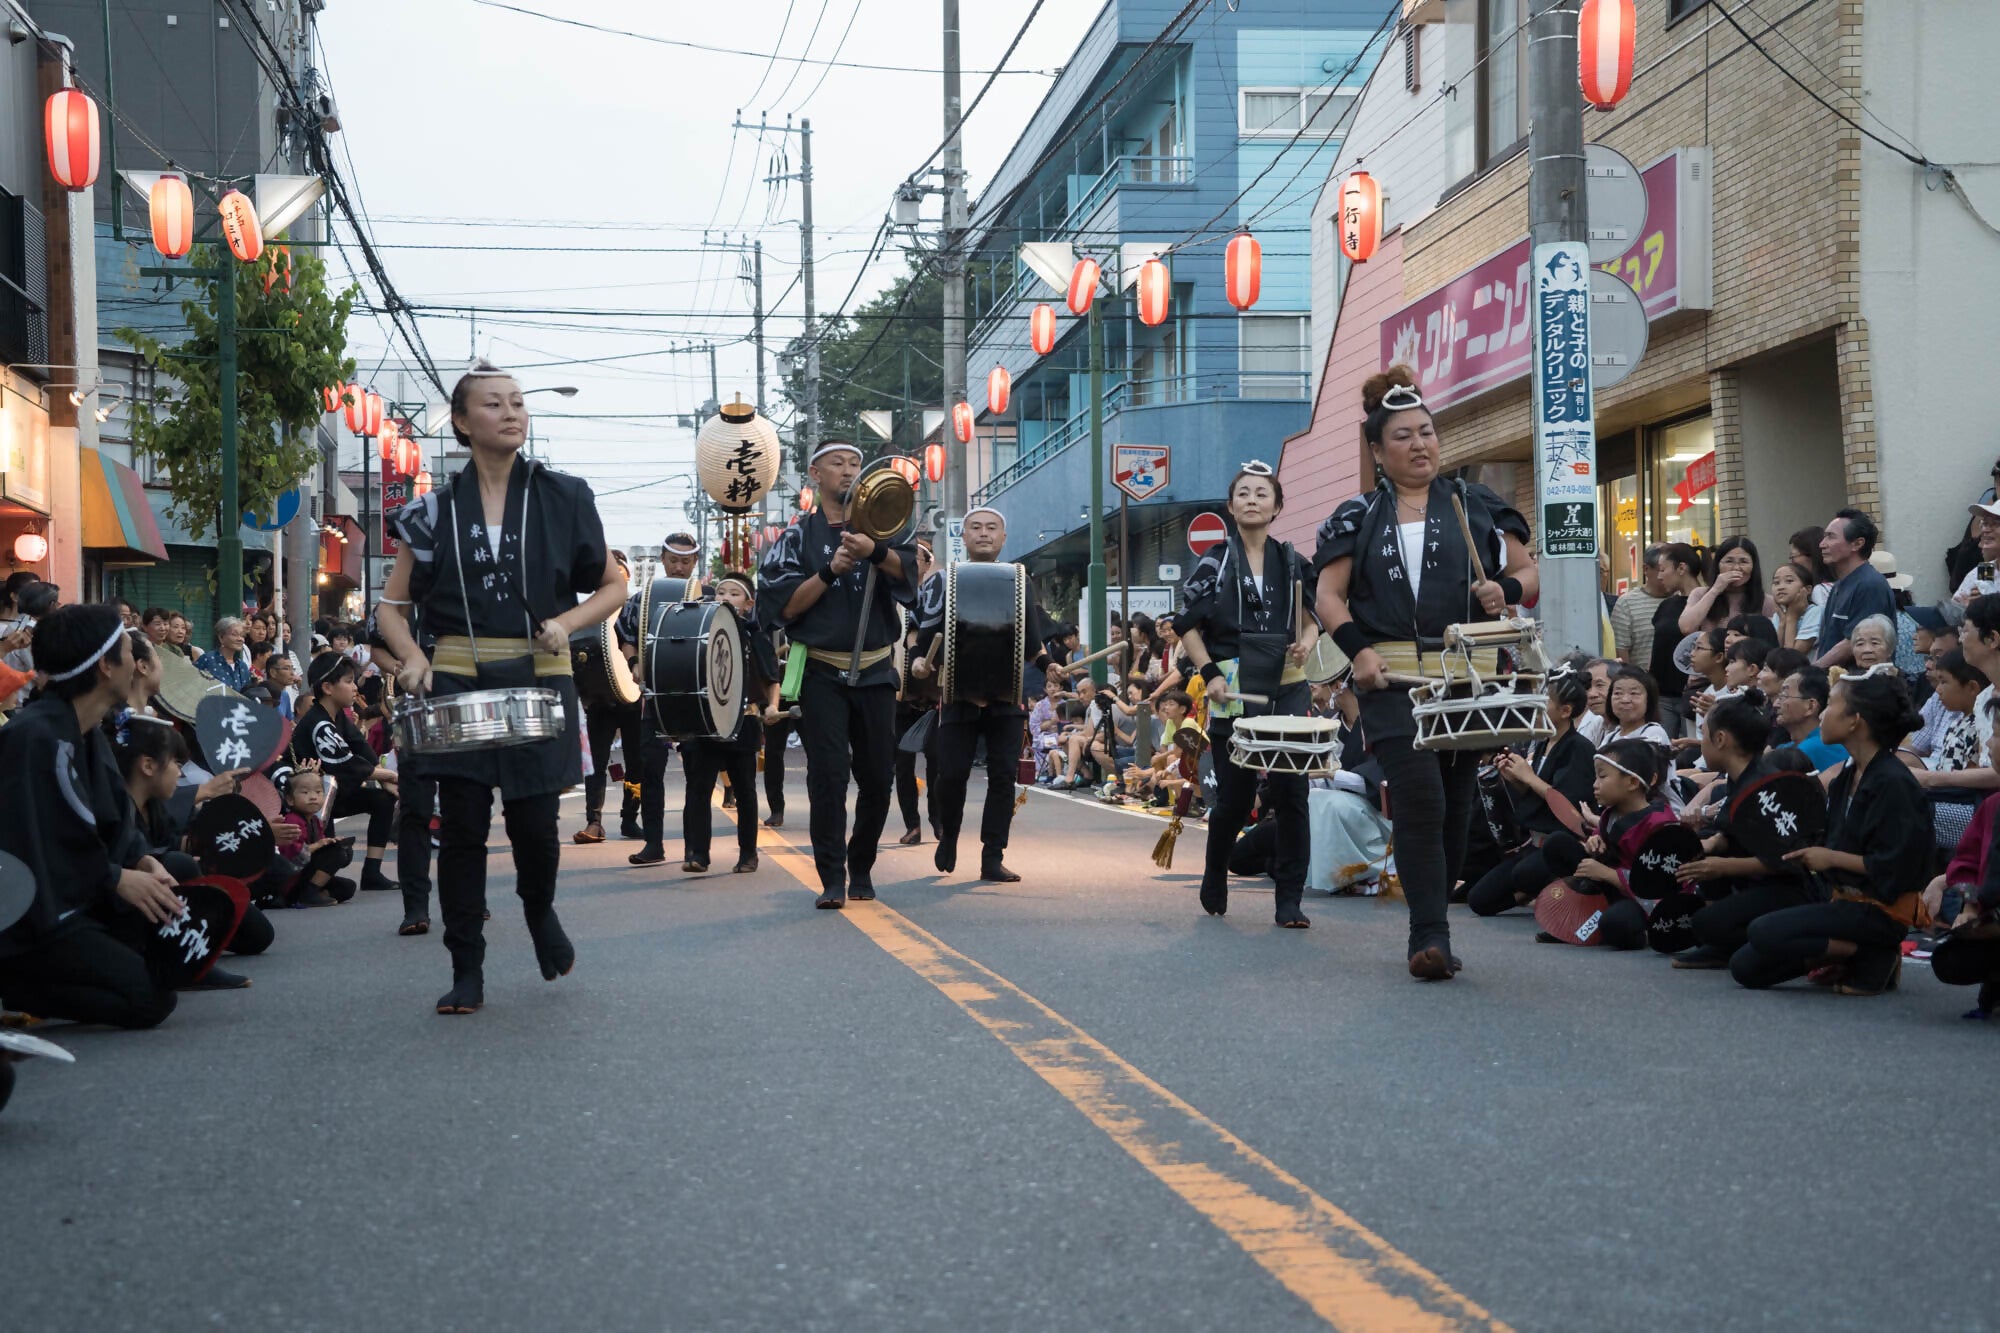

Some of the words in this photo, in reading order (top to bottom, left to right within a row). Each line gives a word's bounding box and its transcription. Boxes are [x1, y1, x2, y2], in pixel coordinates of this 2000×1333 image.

[1344, 190, 1360, 250] 一行寺
[1544, 293, 1567, 420] デンタルクリニック
[1568, 294, 1586, 369] 親と子の
[1575, 395, 1584, 417] 有り
[724, 439, 763, 503] 壱粋
[1426, 517, 1441, 569] いっすい
[1548, 527, 1593, 538] シャンテ大通り
[216, 703, 258, 769] 壱粋
[1758, 790, 1798, 836] 壱粋
